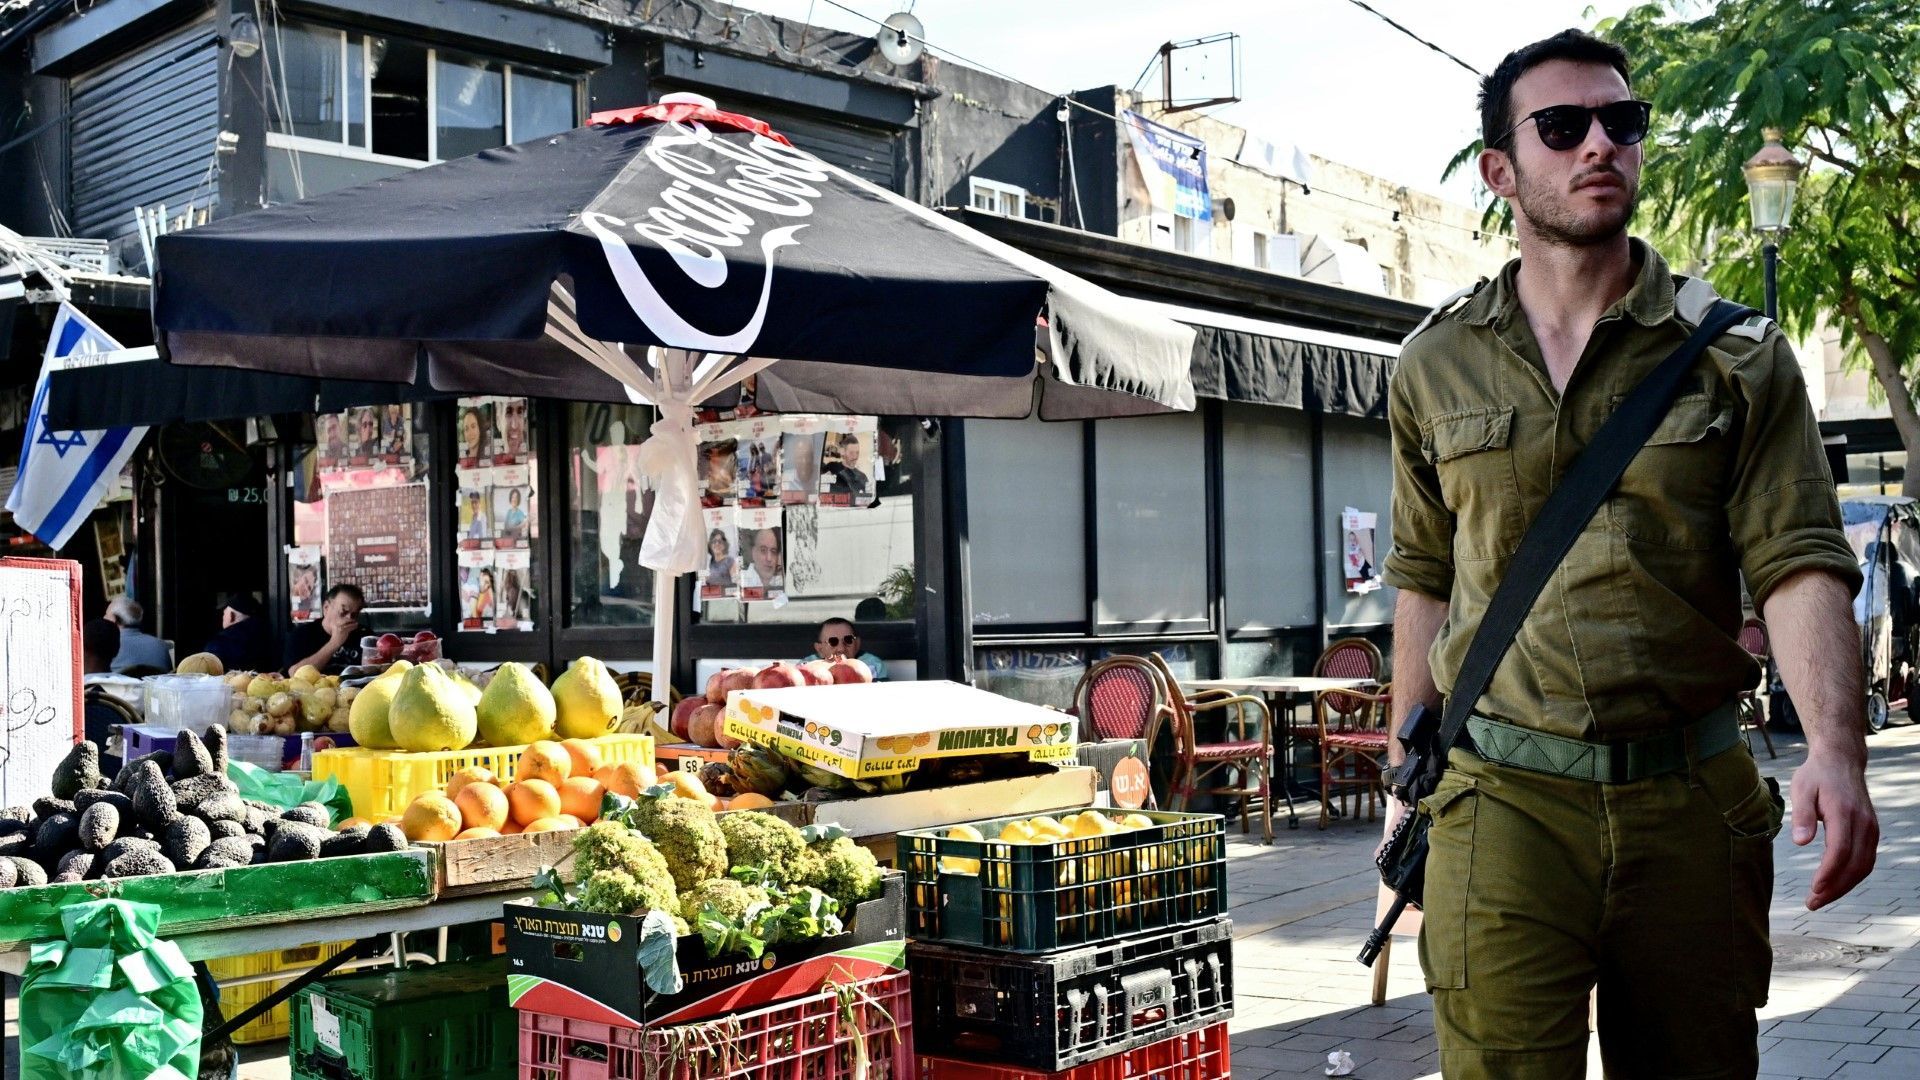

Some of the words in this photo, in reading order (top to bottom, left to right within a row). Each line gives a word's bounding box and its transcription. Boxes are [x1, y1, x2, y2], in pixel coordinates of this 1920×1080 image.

[582, 120, 829, 353] Coca-Cola
[776, 723, 804, 740] PREMIUM
[937, 727, 1018, 751] PREMIUM
[730, 722, 758, 741] פירות
[797, 746, 819, 761] שדה
[824, 755, 843, 770] ניצן
[1034, 749, 1055, 759] שדה
[864, 760, 894, 773] פירות
[897, 757, 917, 770] ניצן
[515, 916, 542, 932] הארץ
[545, 920, 579, 935] תוצרת
[581, 924, 605, 938] טנא
[885, 928, 898, 937] 16.5
[512, 958, 524, 967] 16.5
[735, 960, 760, 974] טנא
[693, 965, 733, 983] תוצרת
